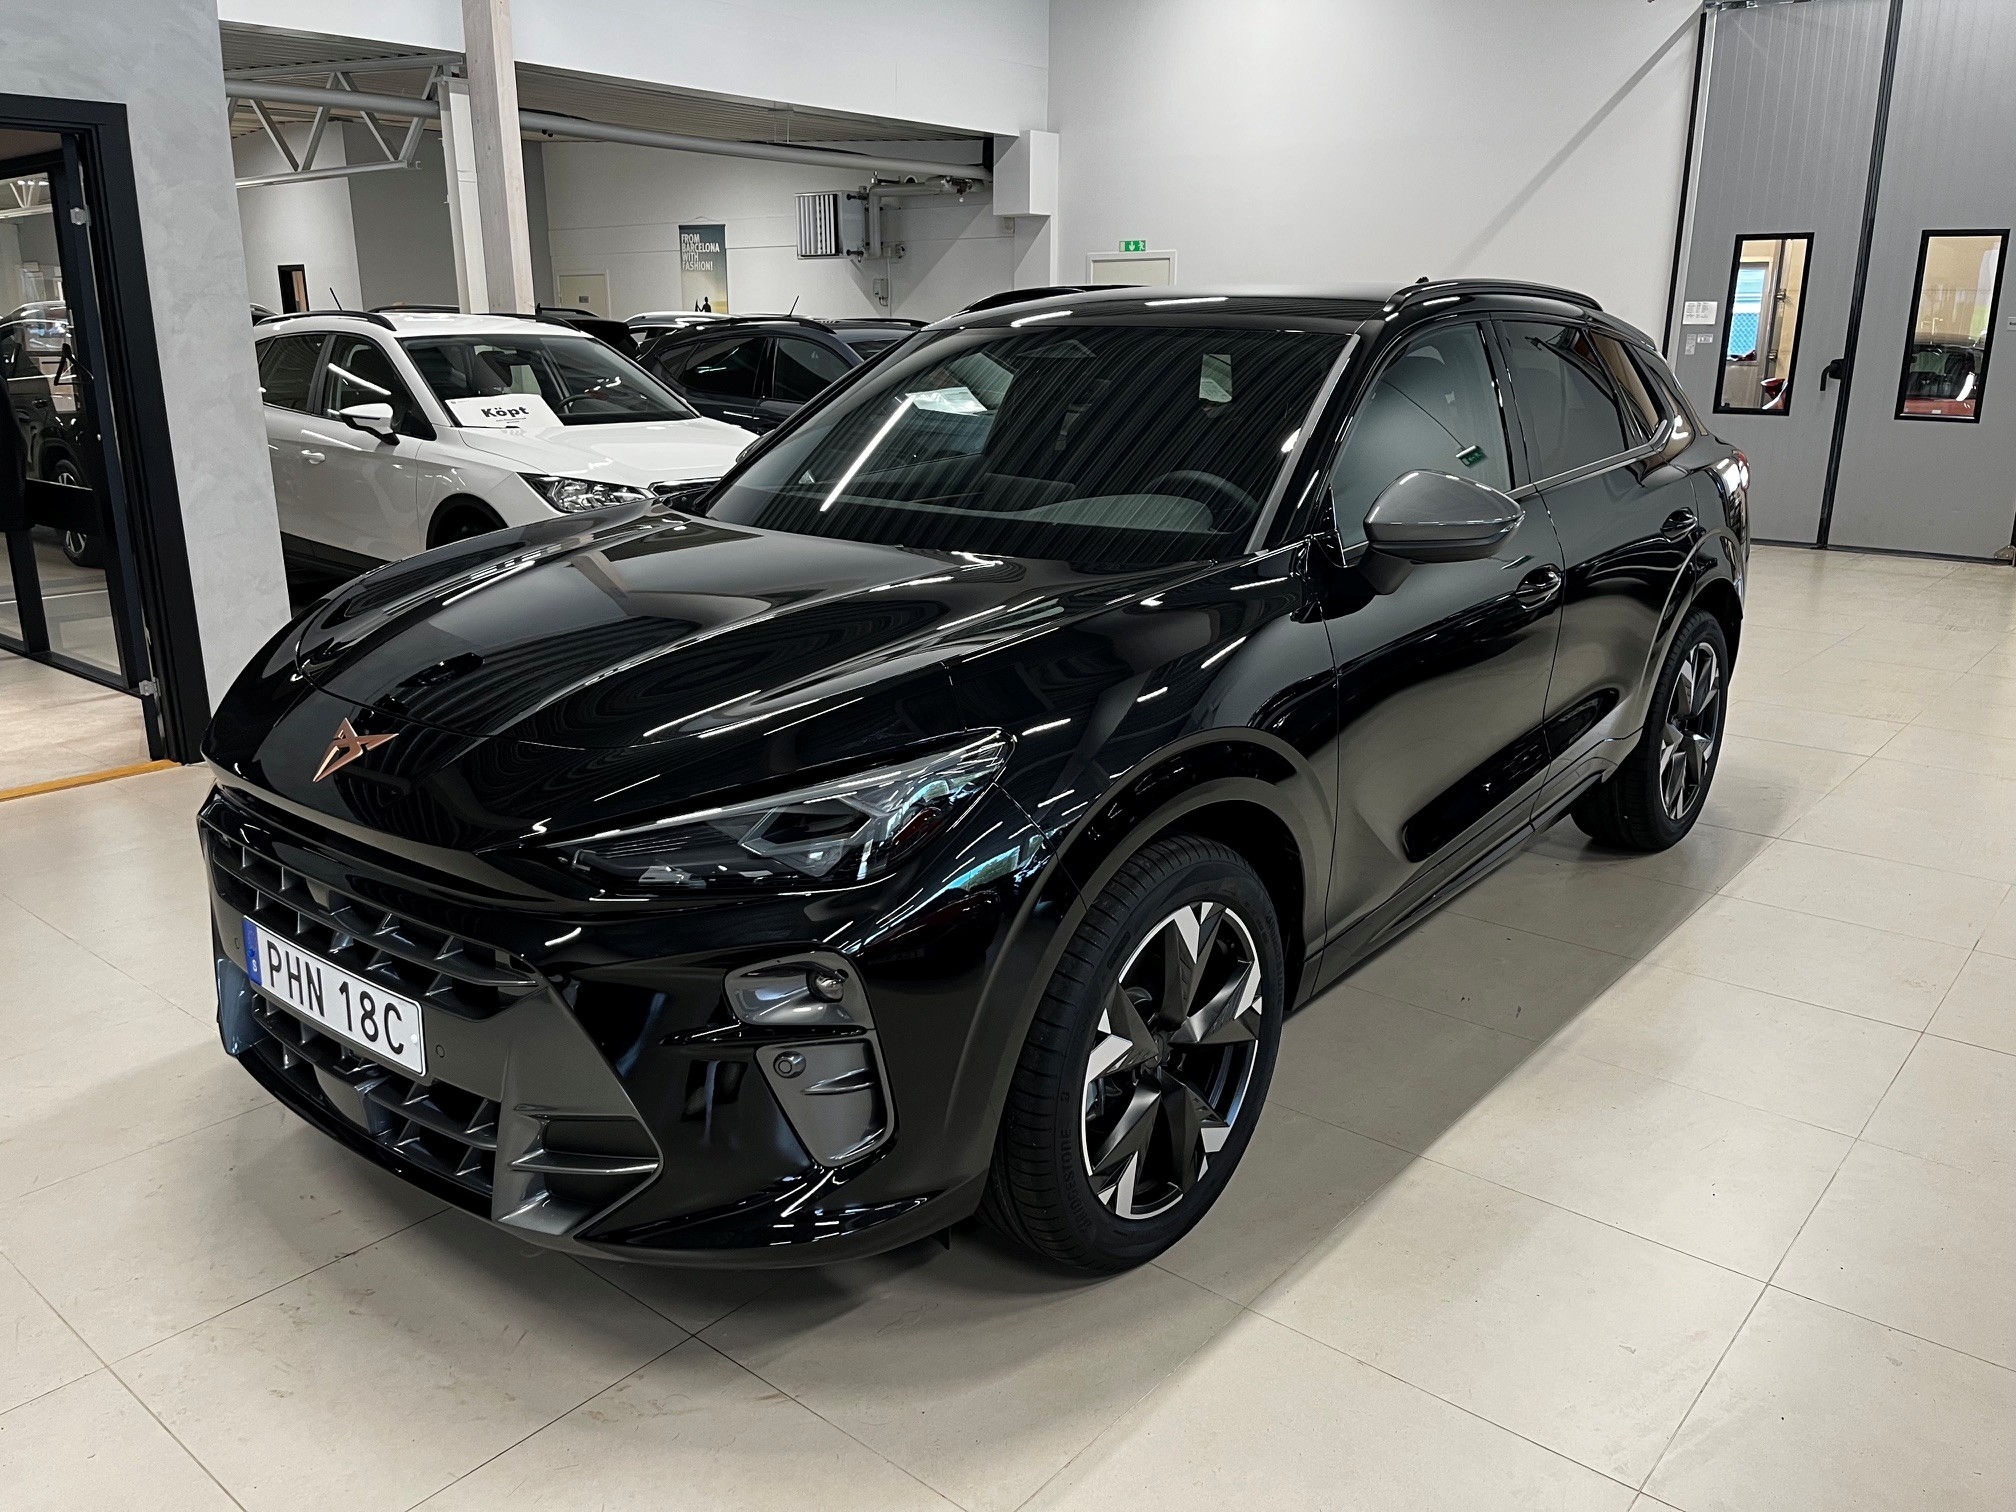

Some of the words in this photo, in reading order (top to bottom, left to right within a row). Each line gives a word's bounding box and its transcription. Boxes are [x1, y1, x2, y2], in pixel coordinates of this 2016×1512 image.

[681, 233, 700, 243] FROM
[681, 242, 720, 252] BARCELONA
[682, 252, 699, 261] WITH
[682, 261, 713, 271] FASHION!
[481, 406, 529, 418] Köpt
[252, 958, 258, 973] S
[266, 939, 325, 1018] PHN
[338, 980, 405, 1056] 18C
